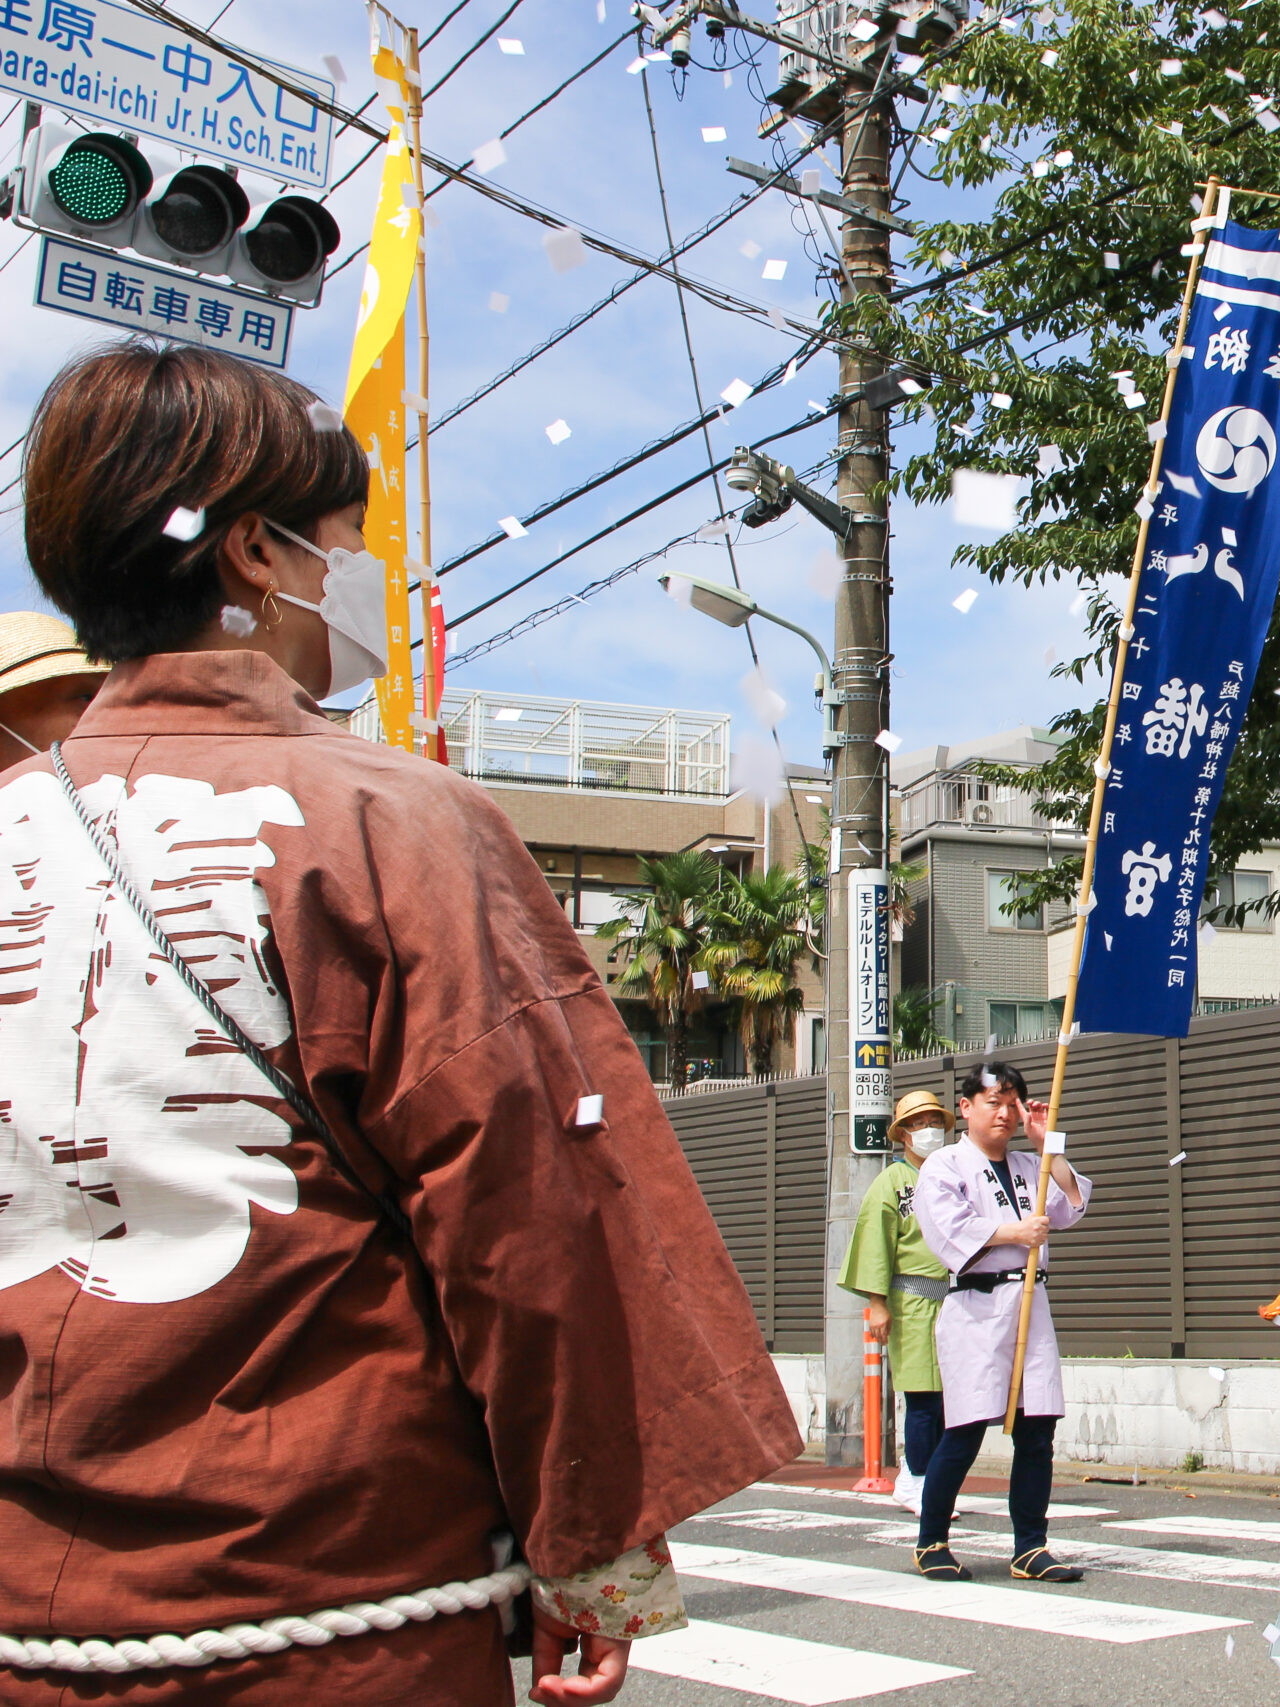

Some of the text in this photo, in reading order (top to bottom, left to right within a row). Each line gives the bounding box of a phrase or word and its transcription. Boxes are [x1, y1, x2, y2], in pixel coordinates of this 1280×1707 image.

[0, 46, 157, 121] ara-dai-ichi
[57, 261, 276, 351] 自転車専用
[859, 892, 873, 1026] モデルルームオープン
